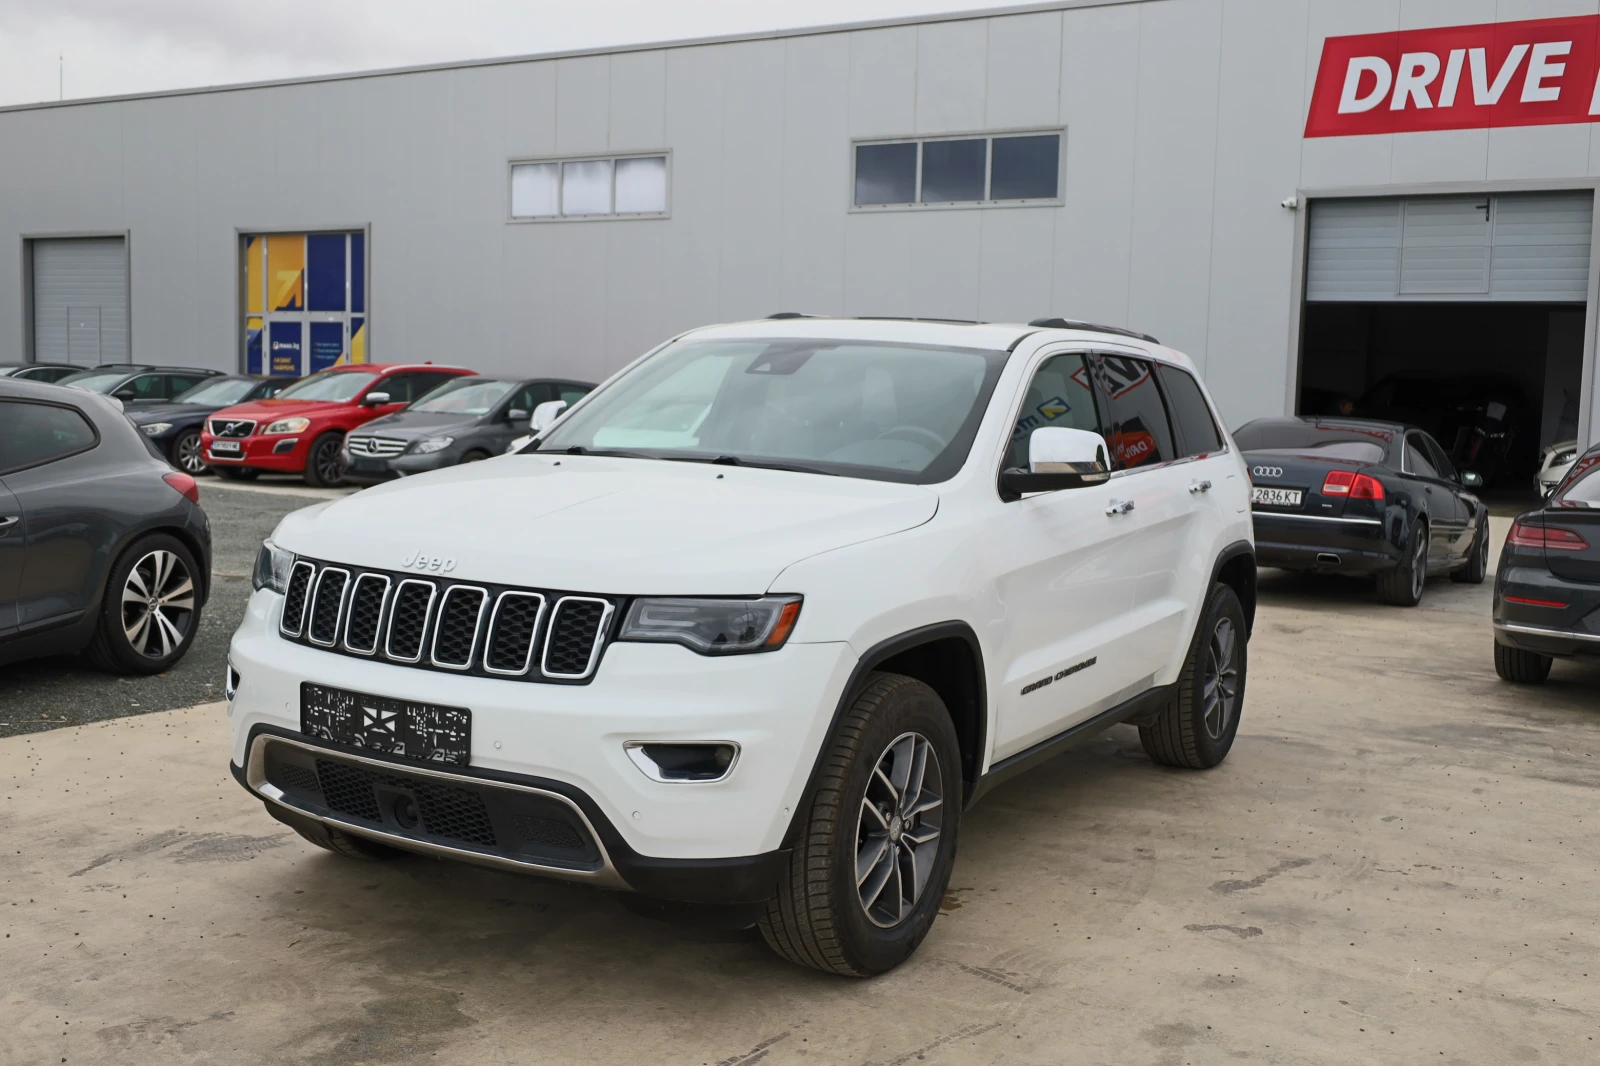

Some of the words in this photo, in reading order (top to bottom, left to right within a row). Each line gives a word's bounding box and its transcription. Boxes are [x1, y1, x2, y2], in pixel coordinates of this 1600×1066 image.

[1337, 40, 1573, 115] DRIVE
[1255, 489, 1283, 501] 2836
[1285, 491, 1300, 503] KT
[401, 549, 457, 575] Jeep
[1020, 676, 1053, 695] GRAND
